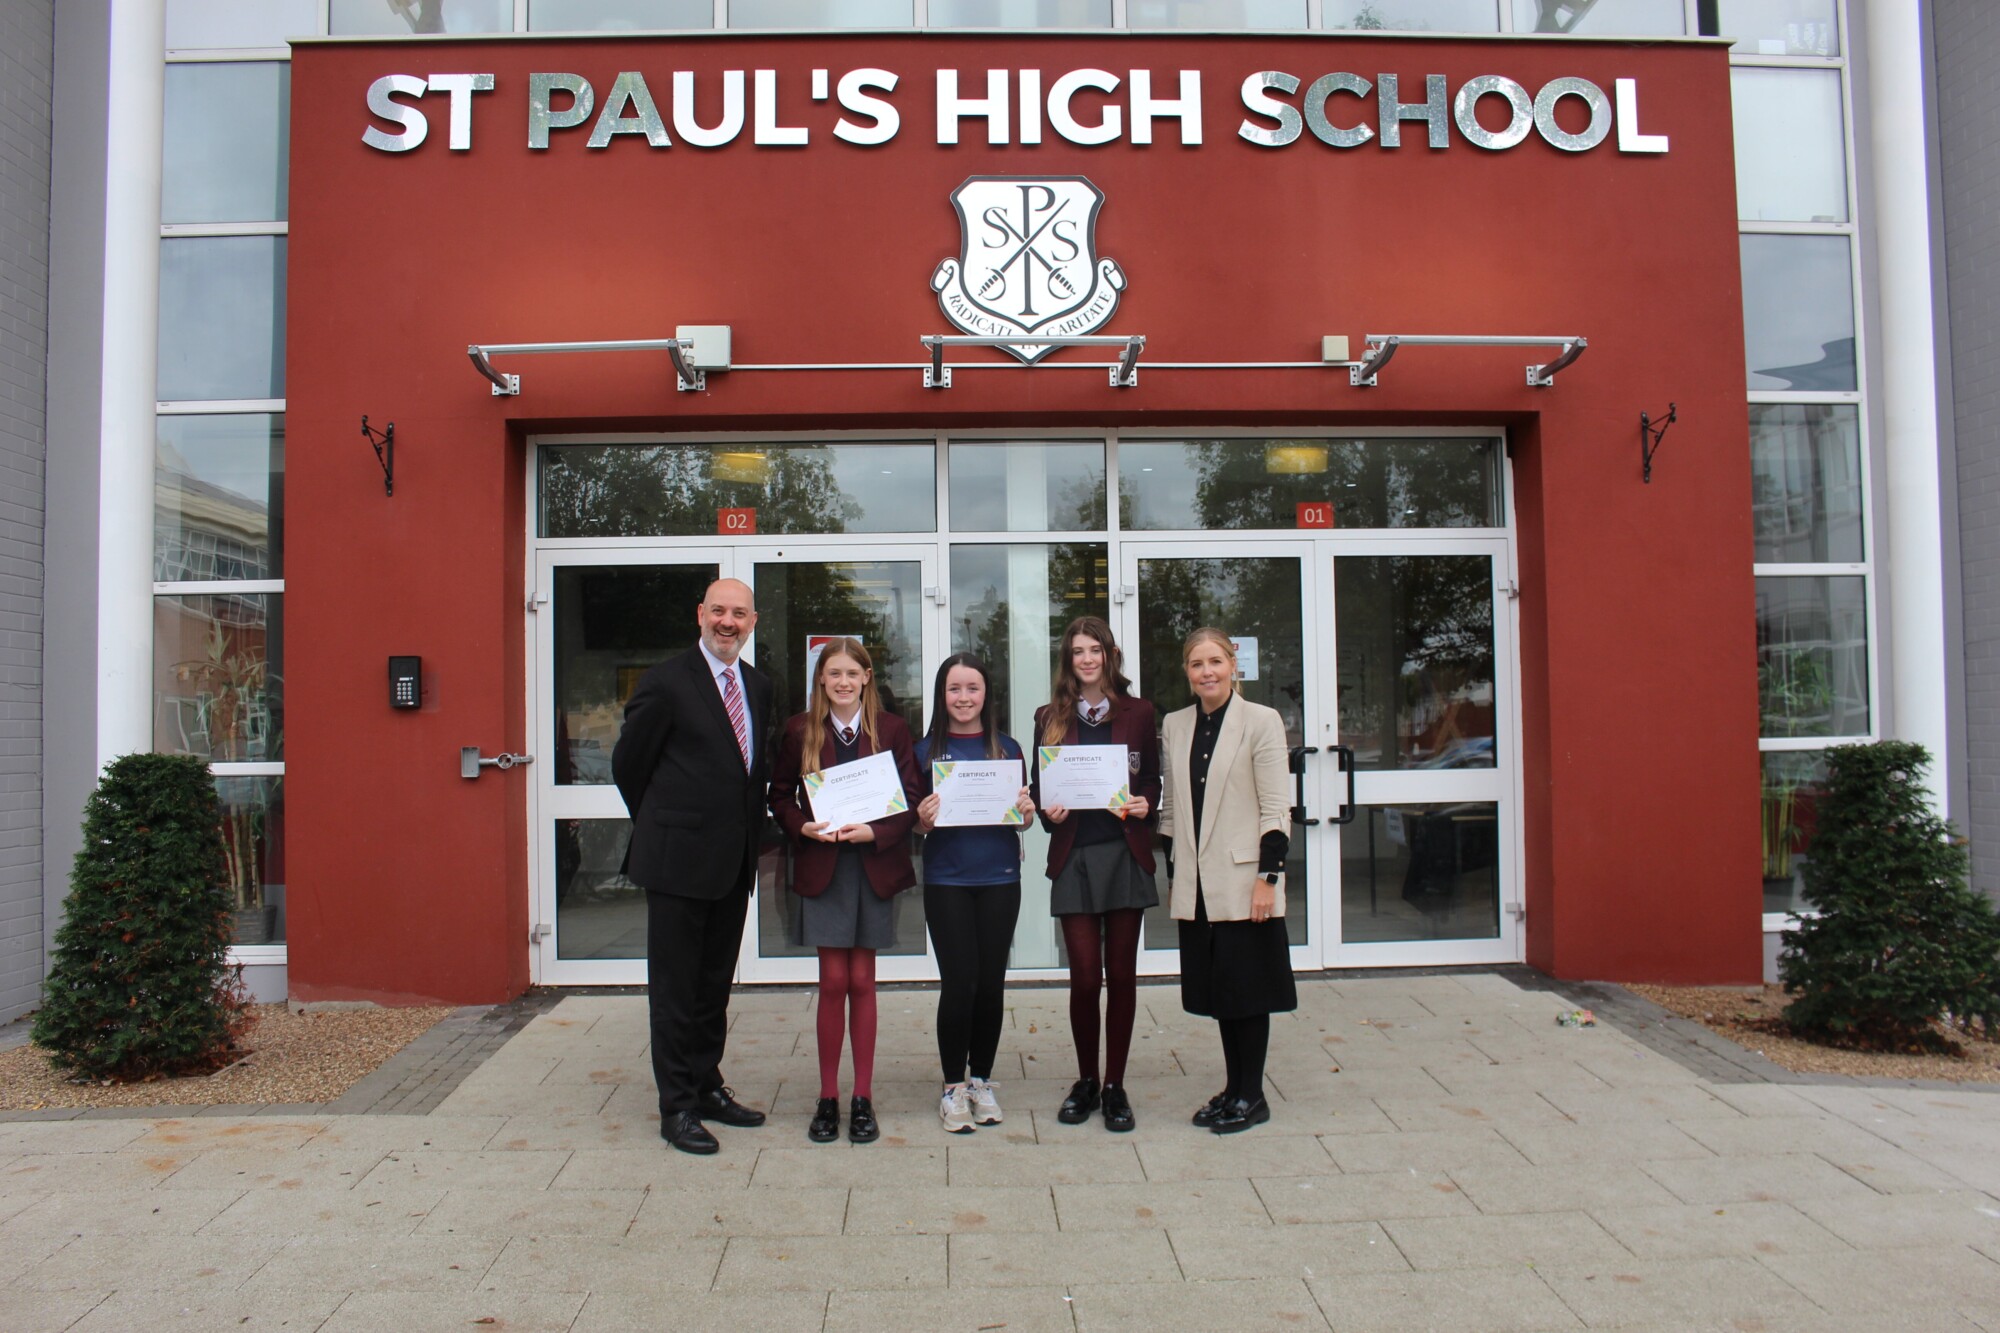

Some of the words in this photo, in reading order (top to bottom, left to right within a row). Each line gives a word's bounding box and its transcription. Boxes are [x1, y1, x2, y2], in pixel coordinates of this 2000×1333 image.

[361, 73, 495, 152] ST
[528, 68, 900, 149] PAUL'S
[936, 68, 1202, 145] HIGH
[1237, 70, 1669, 153] SCHOOL
[726, 513, 747, 529] 02
[1304, 508, 1325, 523] 01
[830, 769, 869, 784] CERTIFICATE
